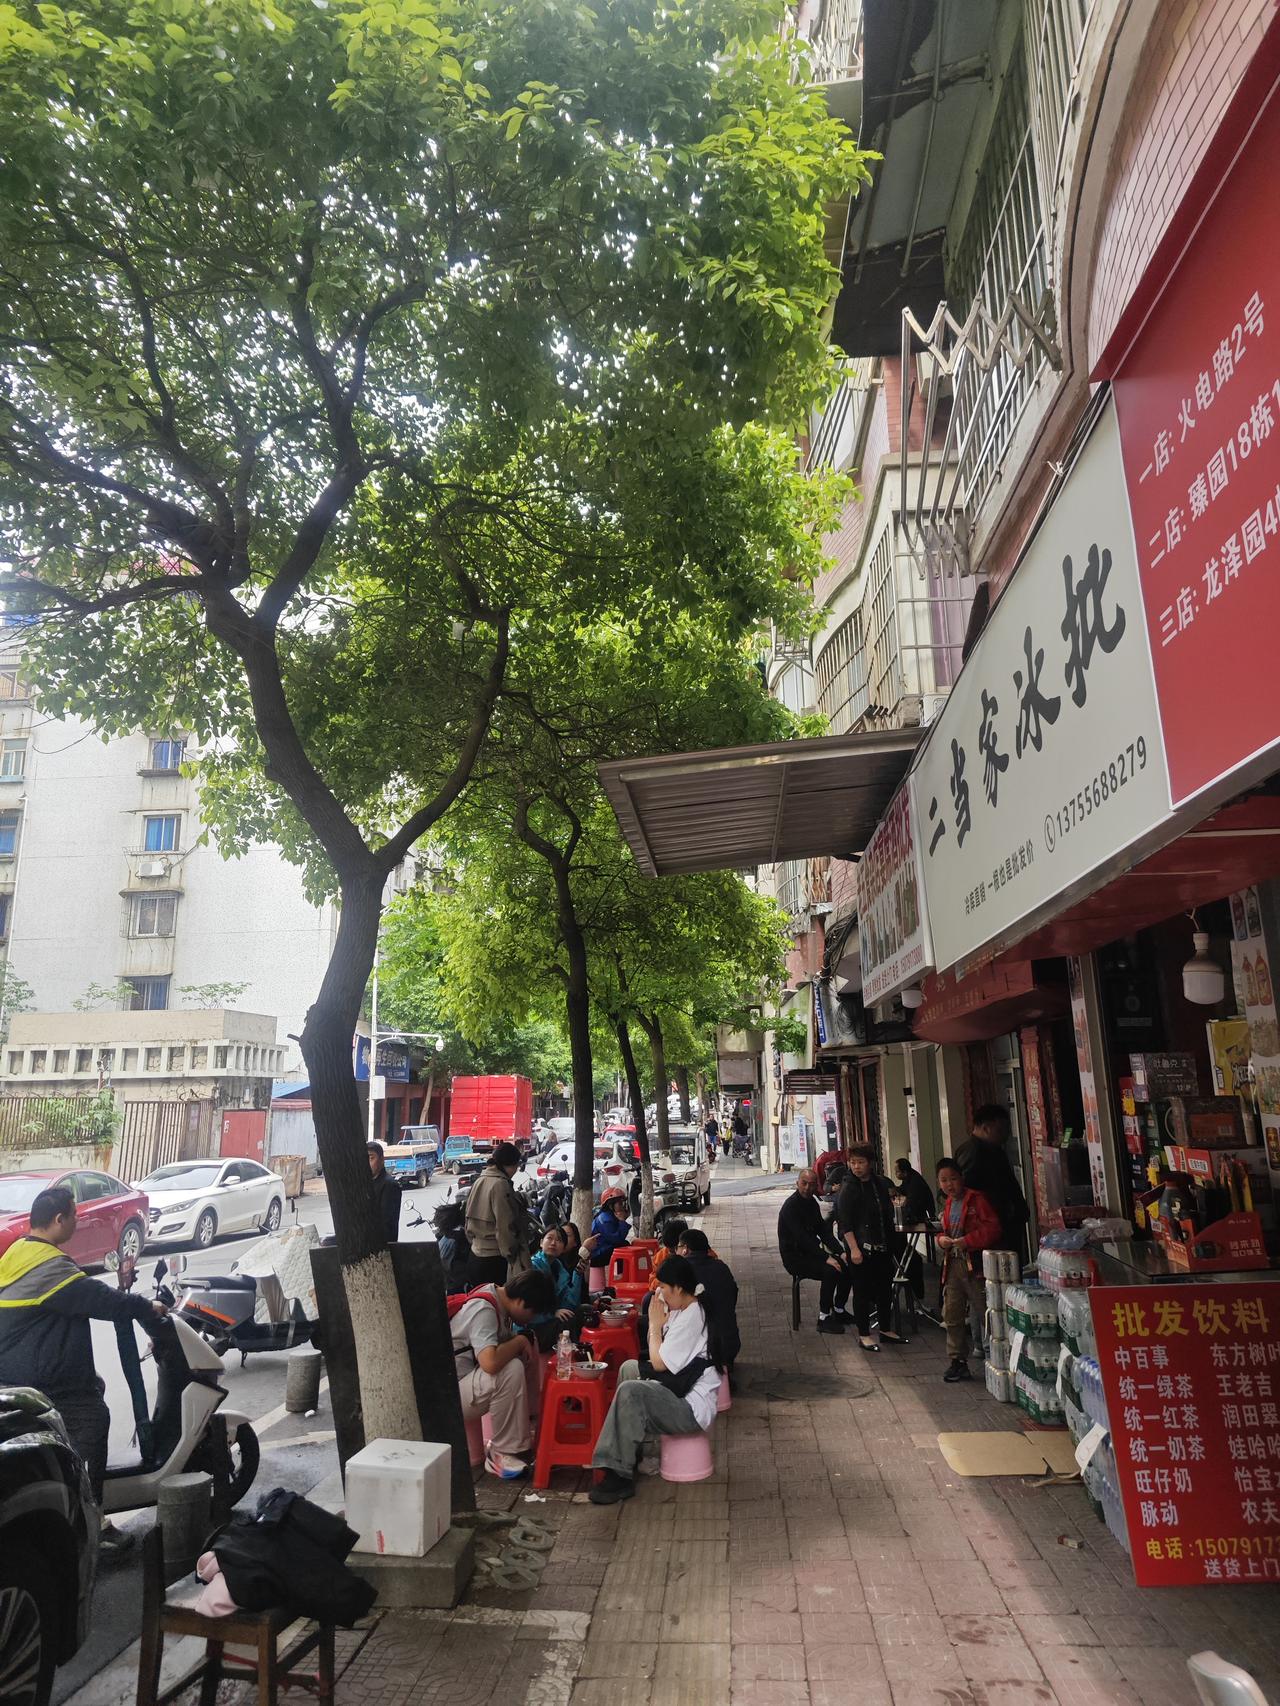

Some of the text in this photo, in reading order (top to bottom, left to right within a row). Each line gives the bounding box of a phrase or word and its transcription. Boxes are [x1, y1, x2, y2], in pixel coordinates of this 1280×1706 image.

[1159, 487, 1280, 647] 三店：龙泽园4
[1056, 735, 1147, 838] 13755688279
[1111, 1297, 1270, 1337] 批发饮料
[1114, 1344, 1170, 1371] 中百事
[1118, 1373, 1194, 1401] 统一绿茶
[1216, 1371, 1273, 1397] 王老吉
[1124, 1404, 1200, 1431] 统一红茶
[1222, 1402, 1280, 1429] 润田翠
[1129, 1435, 1206, 1463] 统一奶茶
[1135, 1467, 1193, 1494] 旺仔奶
[1234, 1465, 1280, 1493] 怡宝
[1139, 1499, 1179, 1528] 脉动
[1242, 1497, 1280, 1525] 农夫
[1204, 1557, 1280, 1579] 送货上门
